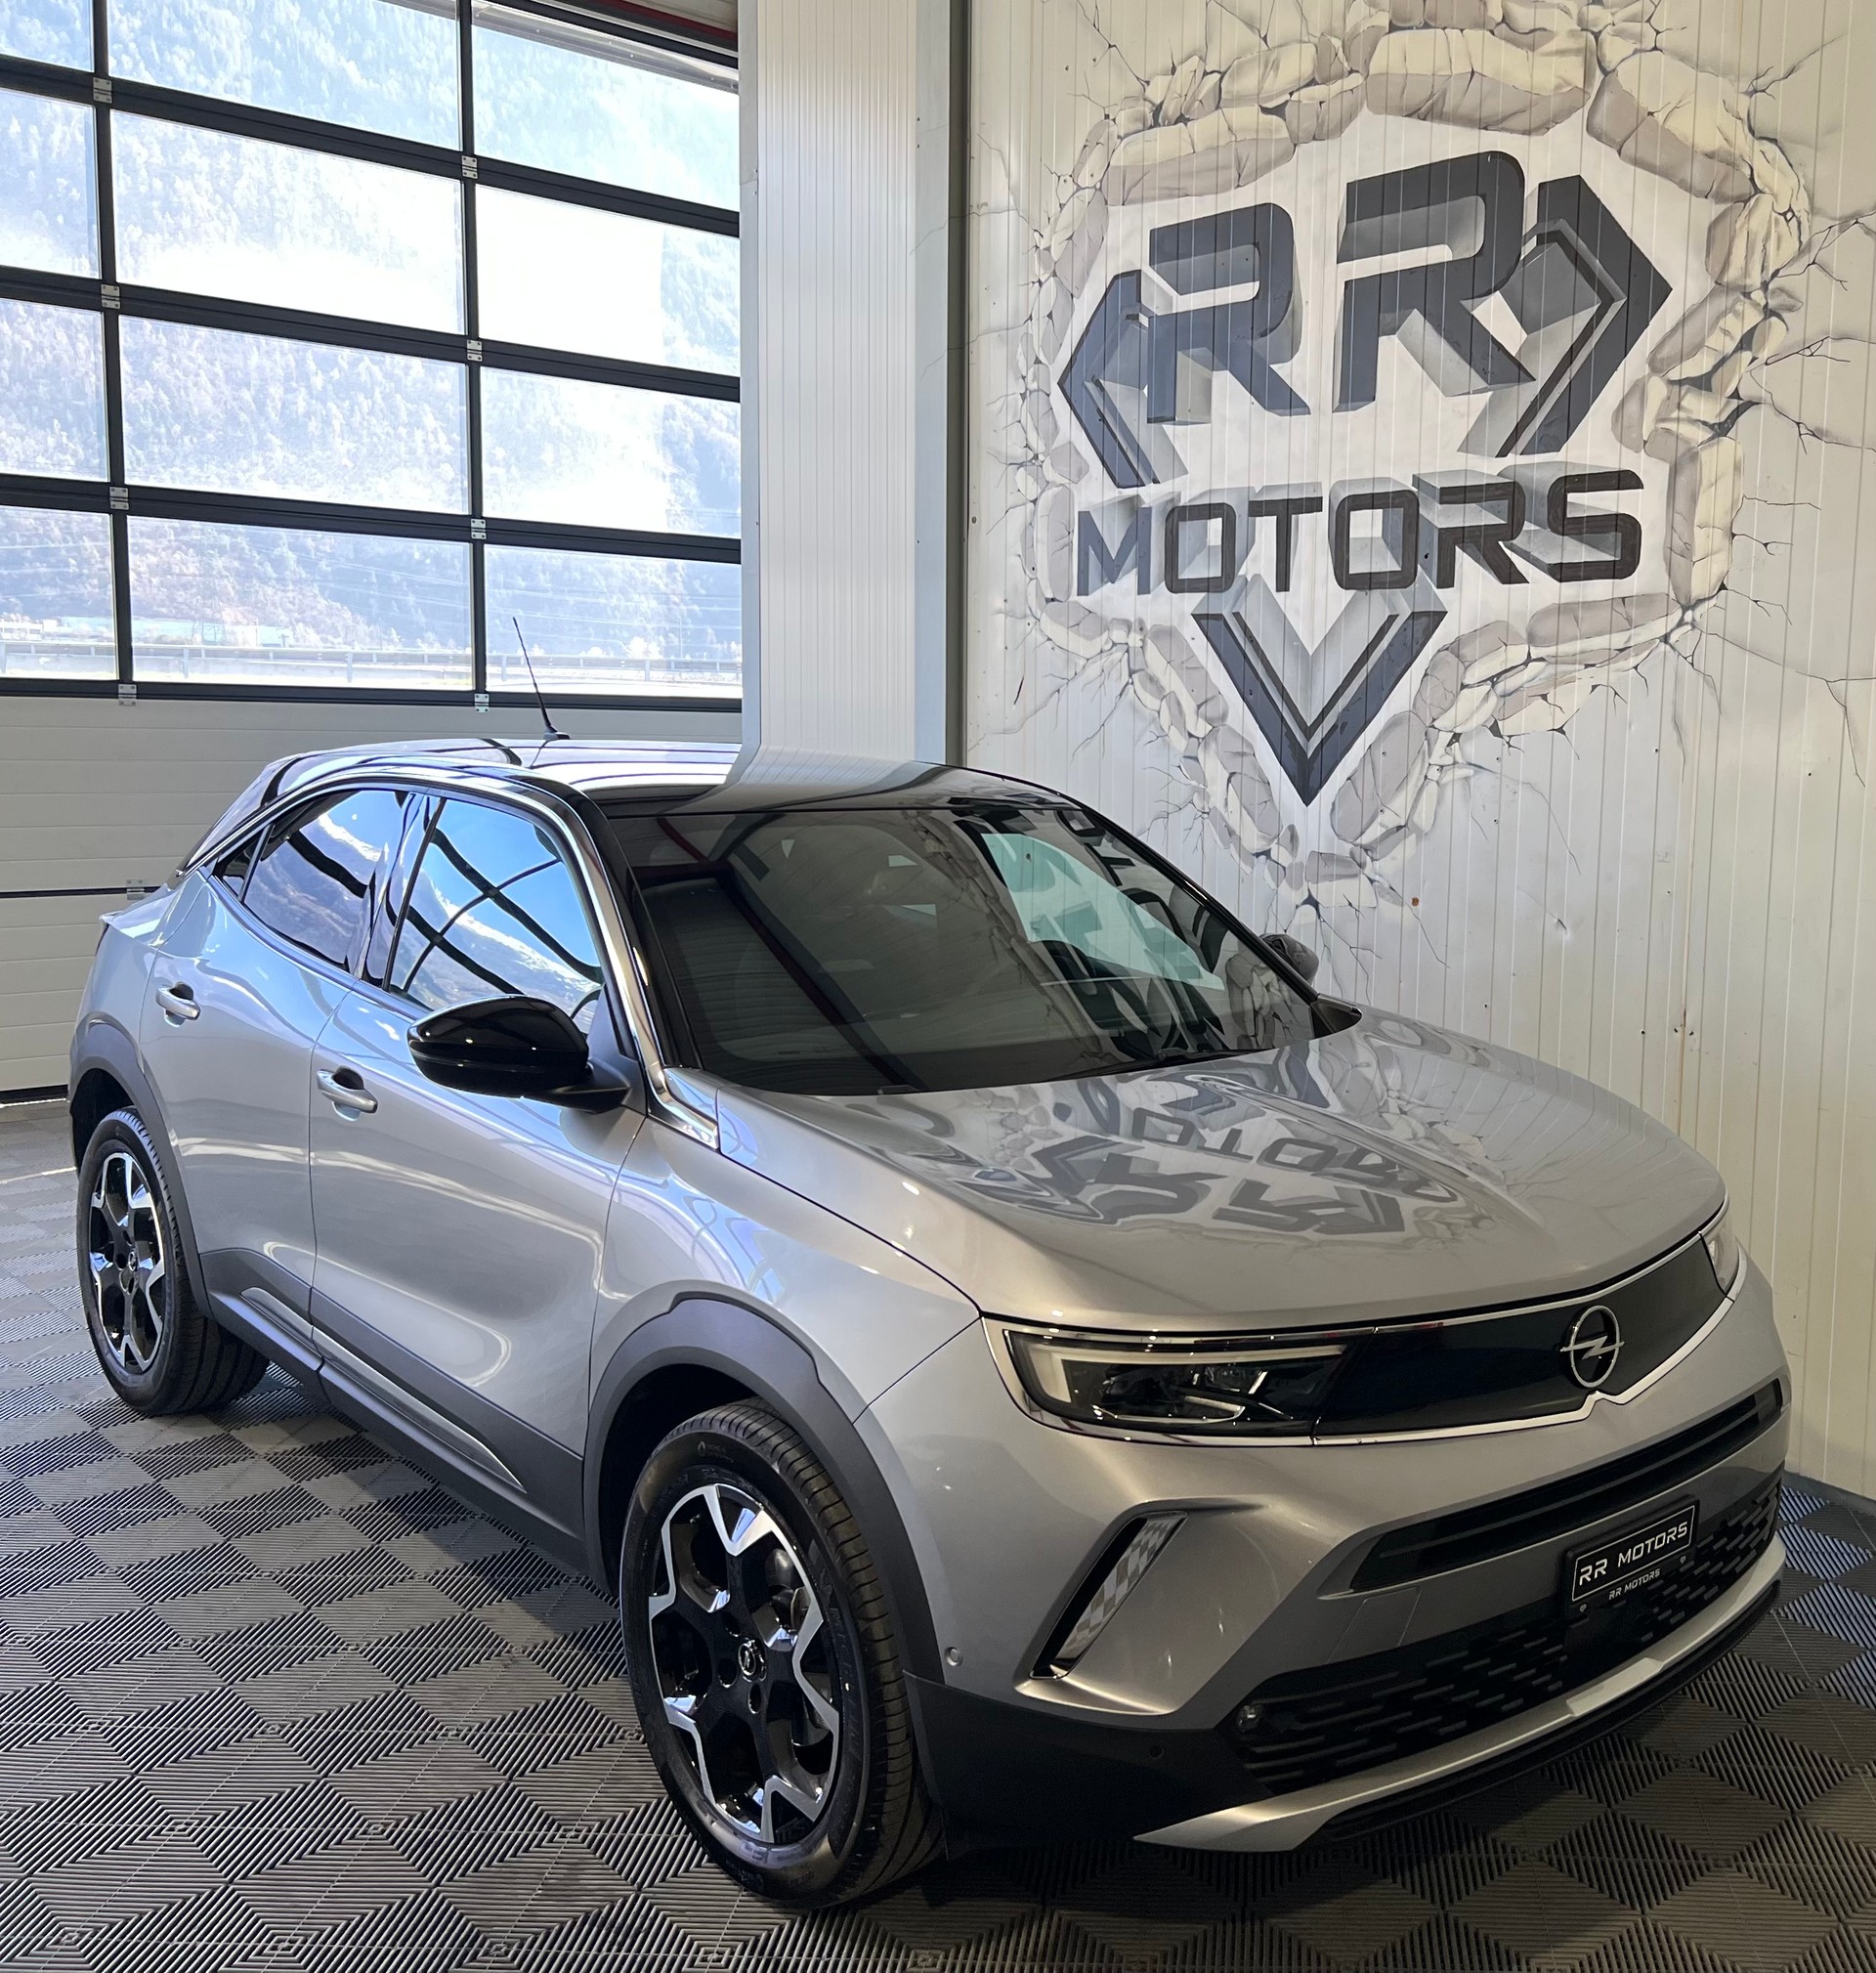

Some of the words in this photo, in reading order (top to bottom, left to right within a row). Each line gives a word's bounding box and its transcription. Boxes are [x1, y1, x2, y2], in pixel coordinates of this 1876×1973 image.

[1146, 150, 1537, 424] RR
[1076, 467, 1645, 597] MOTORS
[1579, 1558, 1608, 1586] RR
[1617, 1521, 1688, 1568] MOTORS
[1608, 1587, 1622, 1601] RR
[1624, 1567, 1661, 1593] MOTORS
